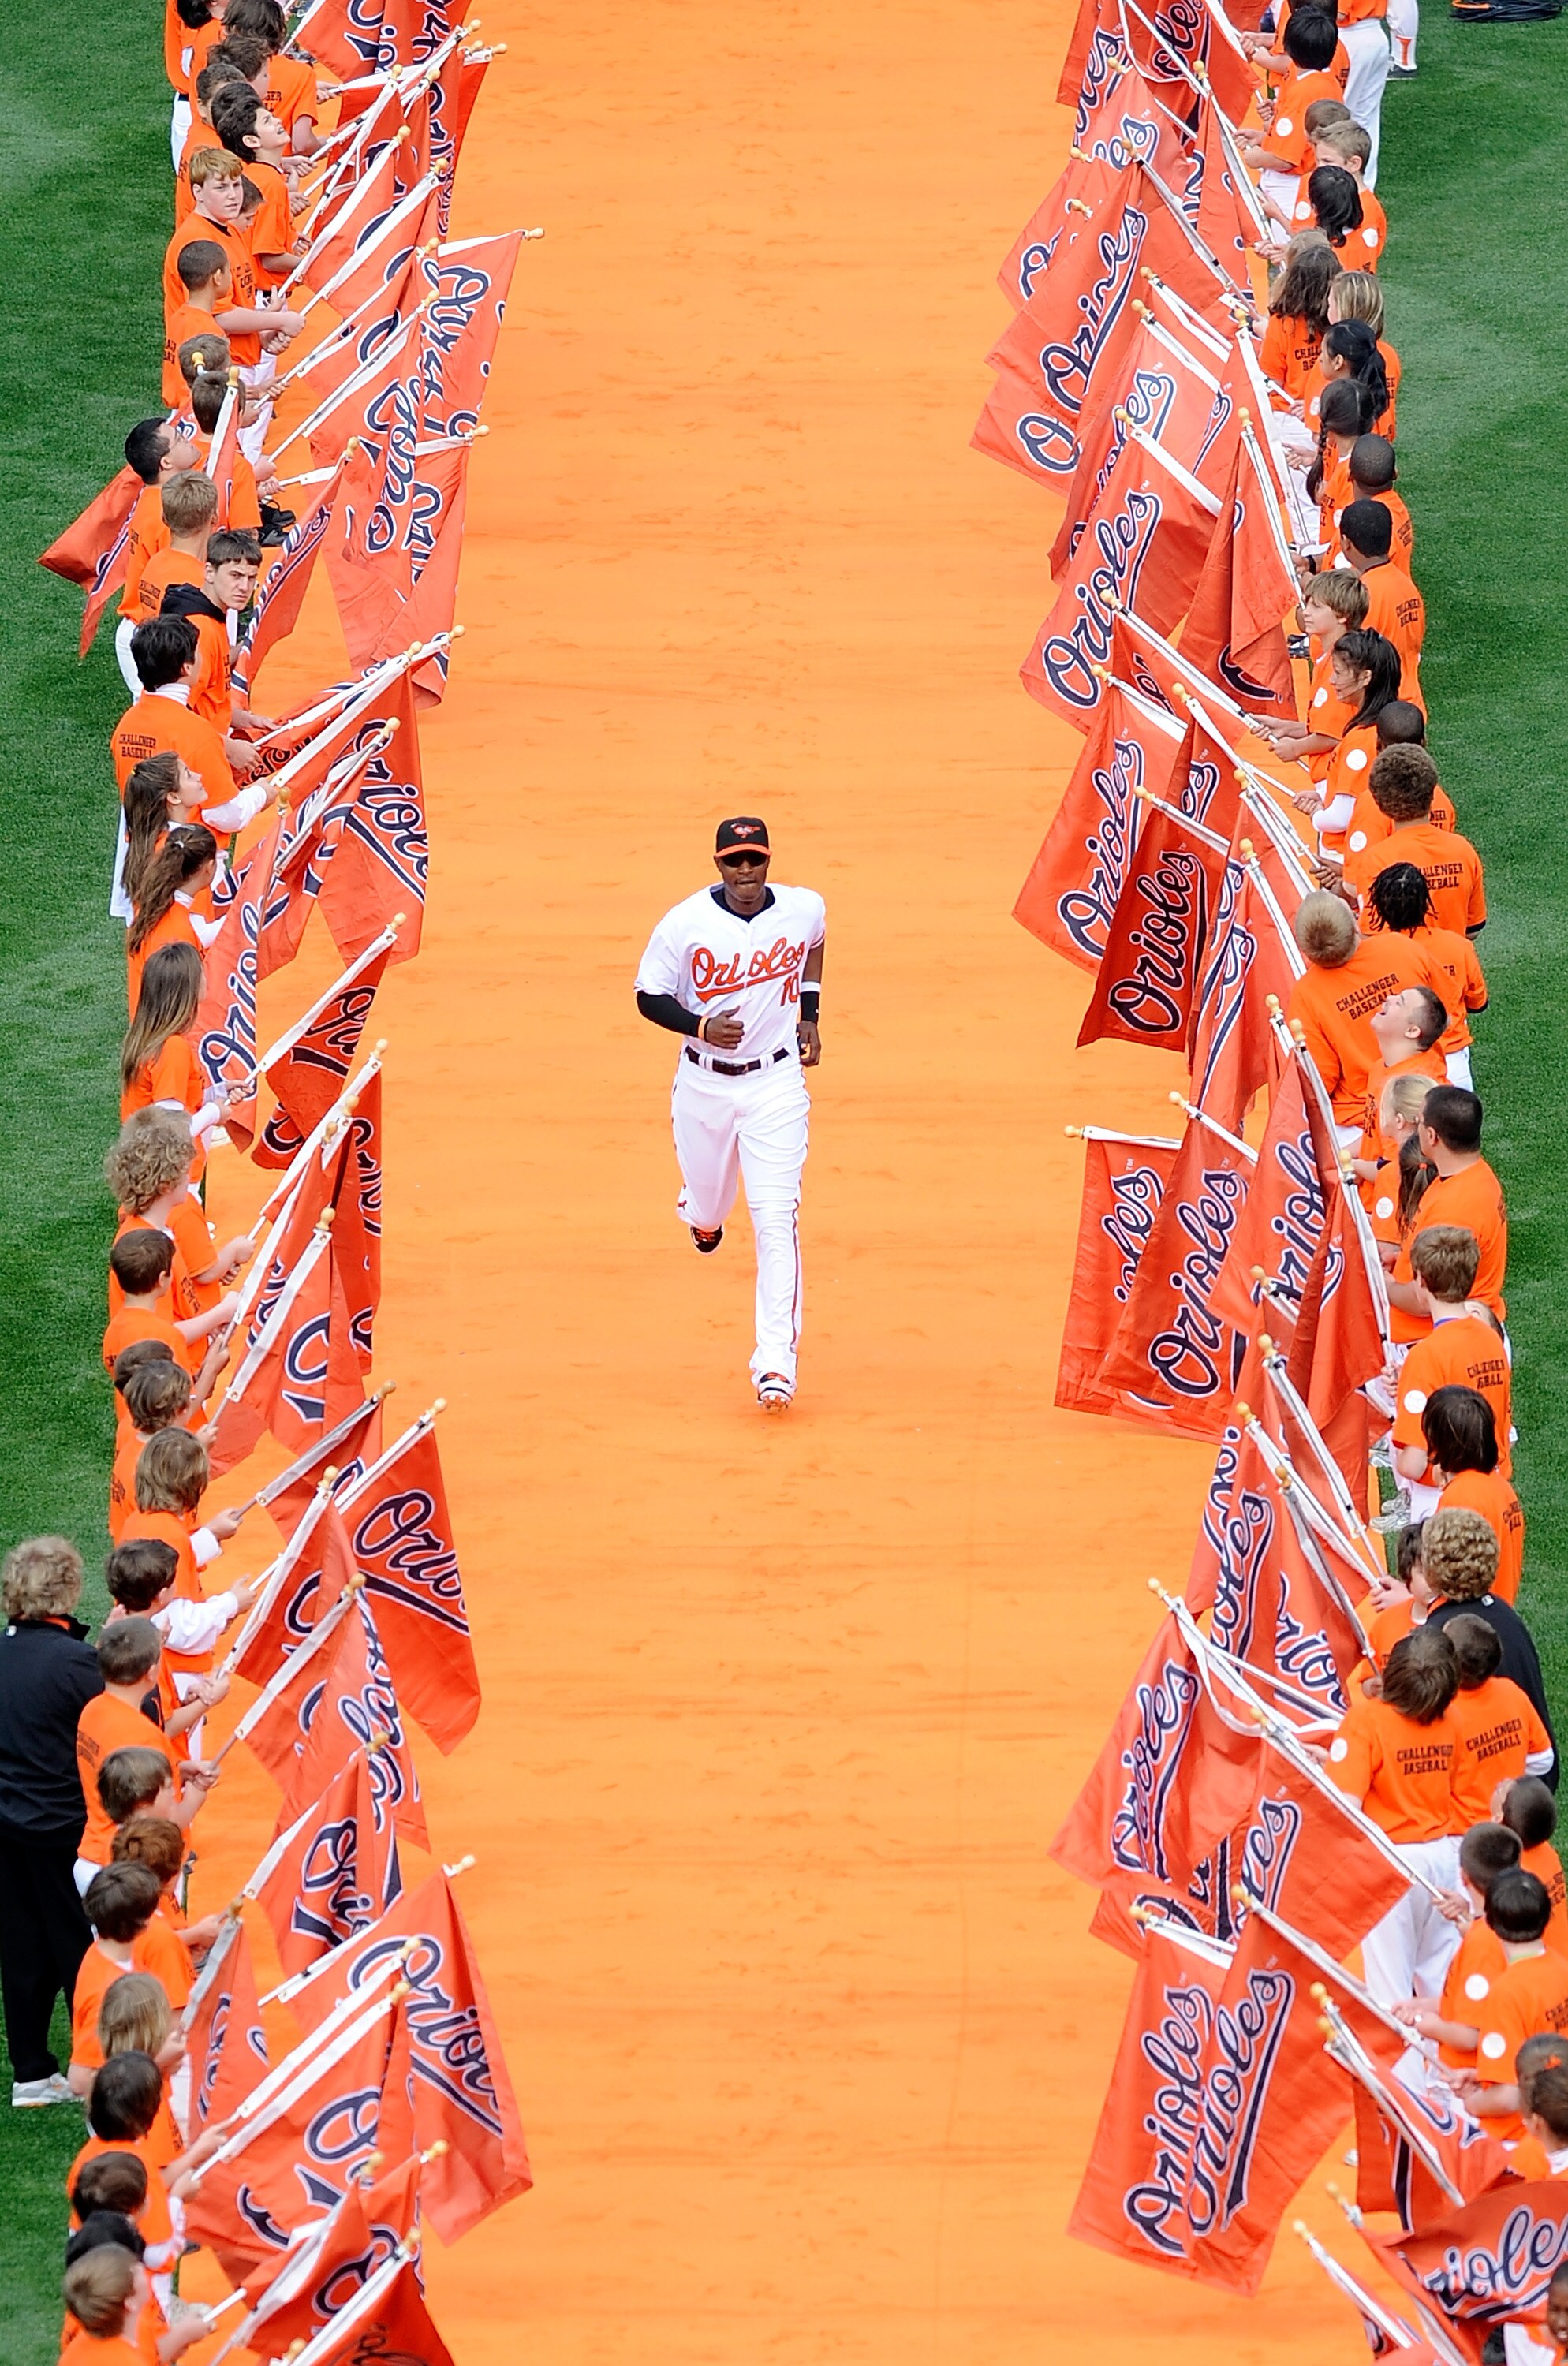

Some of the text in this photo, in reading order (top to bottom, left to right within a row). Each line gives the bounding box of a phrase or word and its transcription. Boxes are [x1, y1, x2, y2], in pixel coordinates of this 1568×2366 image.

[1040, 203, 1148, 413] Orioles
[1042, 487, 1163, 709] Orioles
[1056, 737, 1145, 960] Orioles
[1107, 850, 1209, 1034] Orioles
[691, 937, 805, 991] Orioles
[780, 971, 800, 1006] 10
[1336, 972, 1400, 1013] CHALLENGER
[1148, 1169, 1249, 1398] Orioles
[1122, 1983, 1214, 2259] Orioles
[1188, 1966, 1297, 2238] Orioles
[1423, 2204, 1568, 2314] riole
